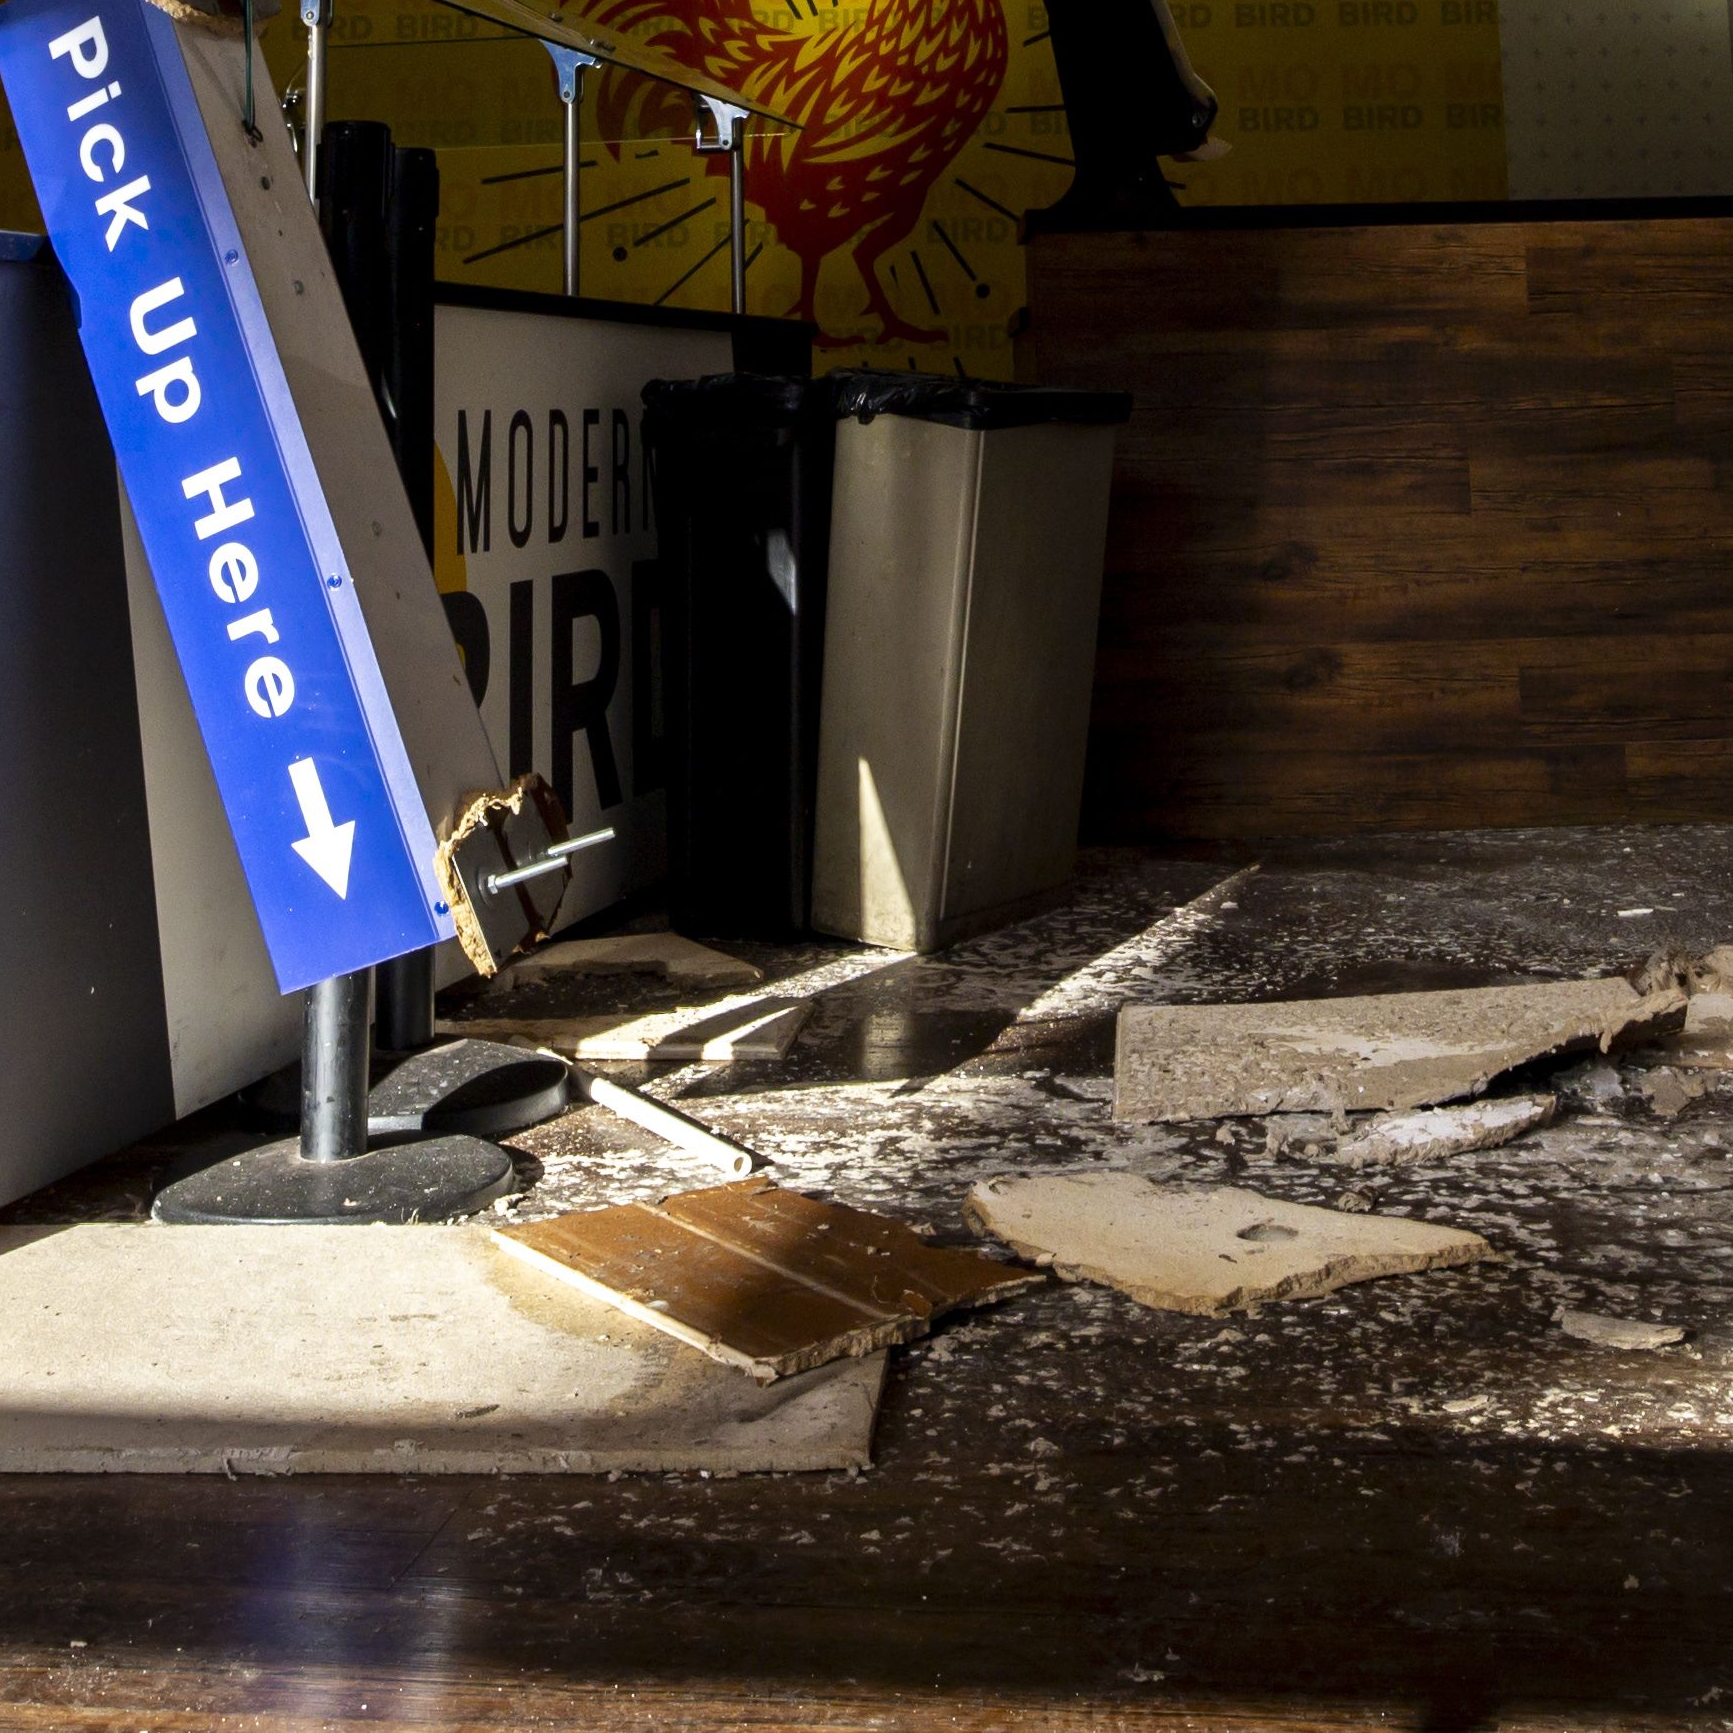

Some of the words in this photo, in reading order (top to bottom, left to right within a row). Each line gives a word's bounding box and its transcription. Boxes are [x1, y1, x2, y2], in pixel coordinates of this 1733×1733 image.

[1235, 2, 1315, 27] BIRD
[1338, 1, 1418, 26] BIRD
[292, 15, 372, 40] BRD
[1239, 106, 1319, 132] BIRD
[1344, 105, 1423, 130] BIRD
[47, 14, 153, 252] Pick
[129, 275, 202, 424] Up
[181, 456, 296, 720] Here
